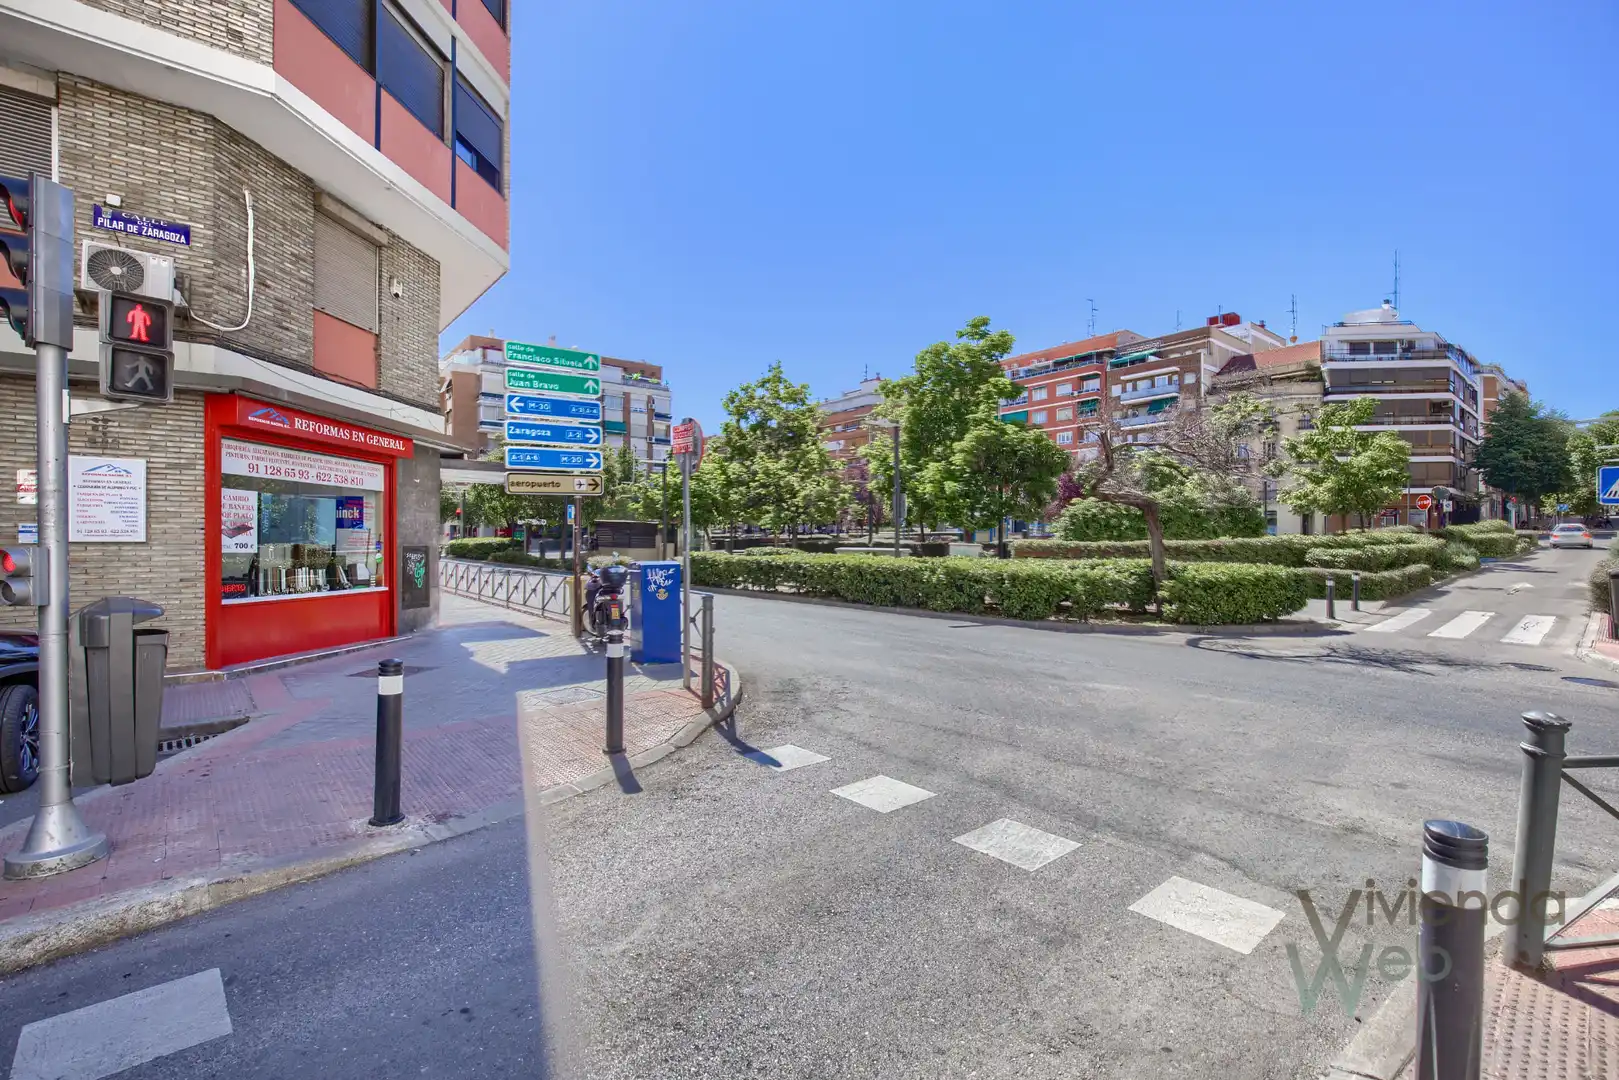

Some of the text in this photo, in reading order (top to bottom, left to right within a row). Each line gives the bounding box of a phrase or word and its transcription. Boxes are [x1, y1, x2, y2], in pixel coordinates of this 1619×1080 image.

[122, 212, 167, 227] CALLE
[137, 220, 154, 228] DEL
[97, 217, 186, 244] PILAR DE ZARAGOZA
[507, 350, 583, 368] Francisco Silvela
[509, 378, 560, 390] Juan Bravo
[528, 402, 548, 410] M-30
[294, 417, 405, 451] REFORMAS EN GENERAL
[508, 426, 551, 437] Zaragoza
[248, 463, 260, 474] 91
[264, 464, 281, 477] 128
[284, 468, 296, 478] 65
[298, 468, 310, 480] 93
[316, 471, 332, 482] 622
[333, 473, 349, 484] 538
[350, 475, 364, 486] 810
[510, 480, 561, 489] aeropuerto
[234, 542, 248, 550] 700
